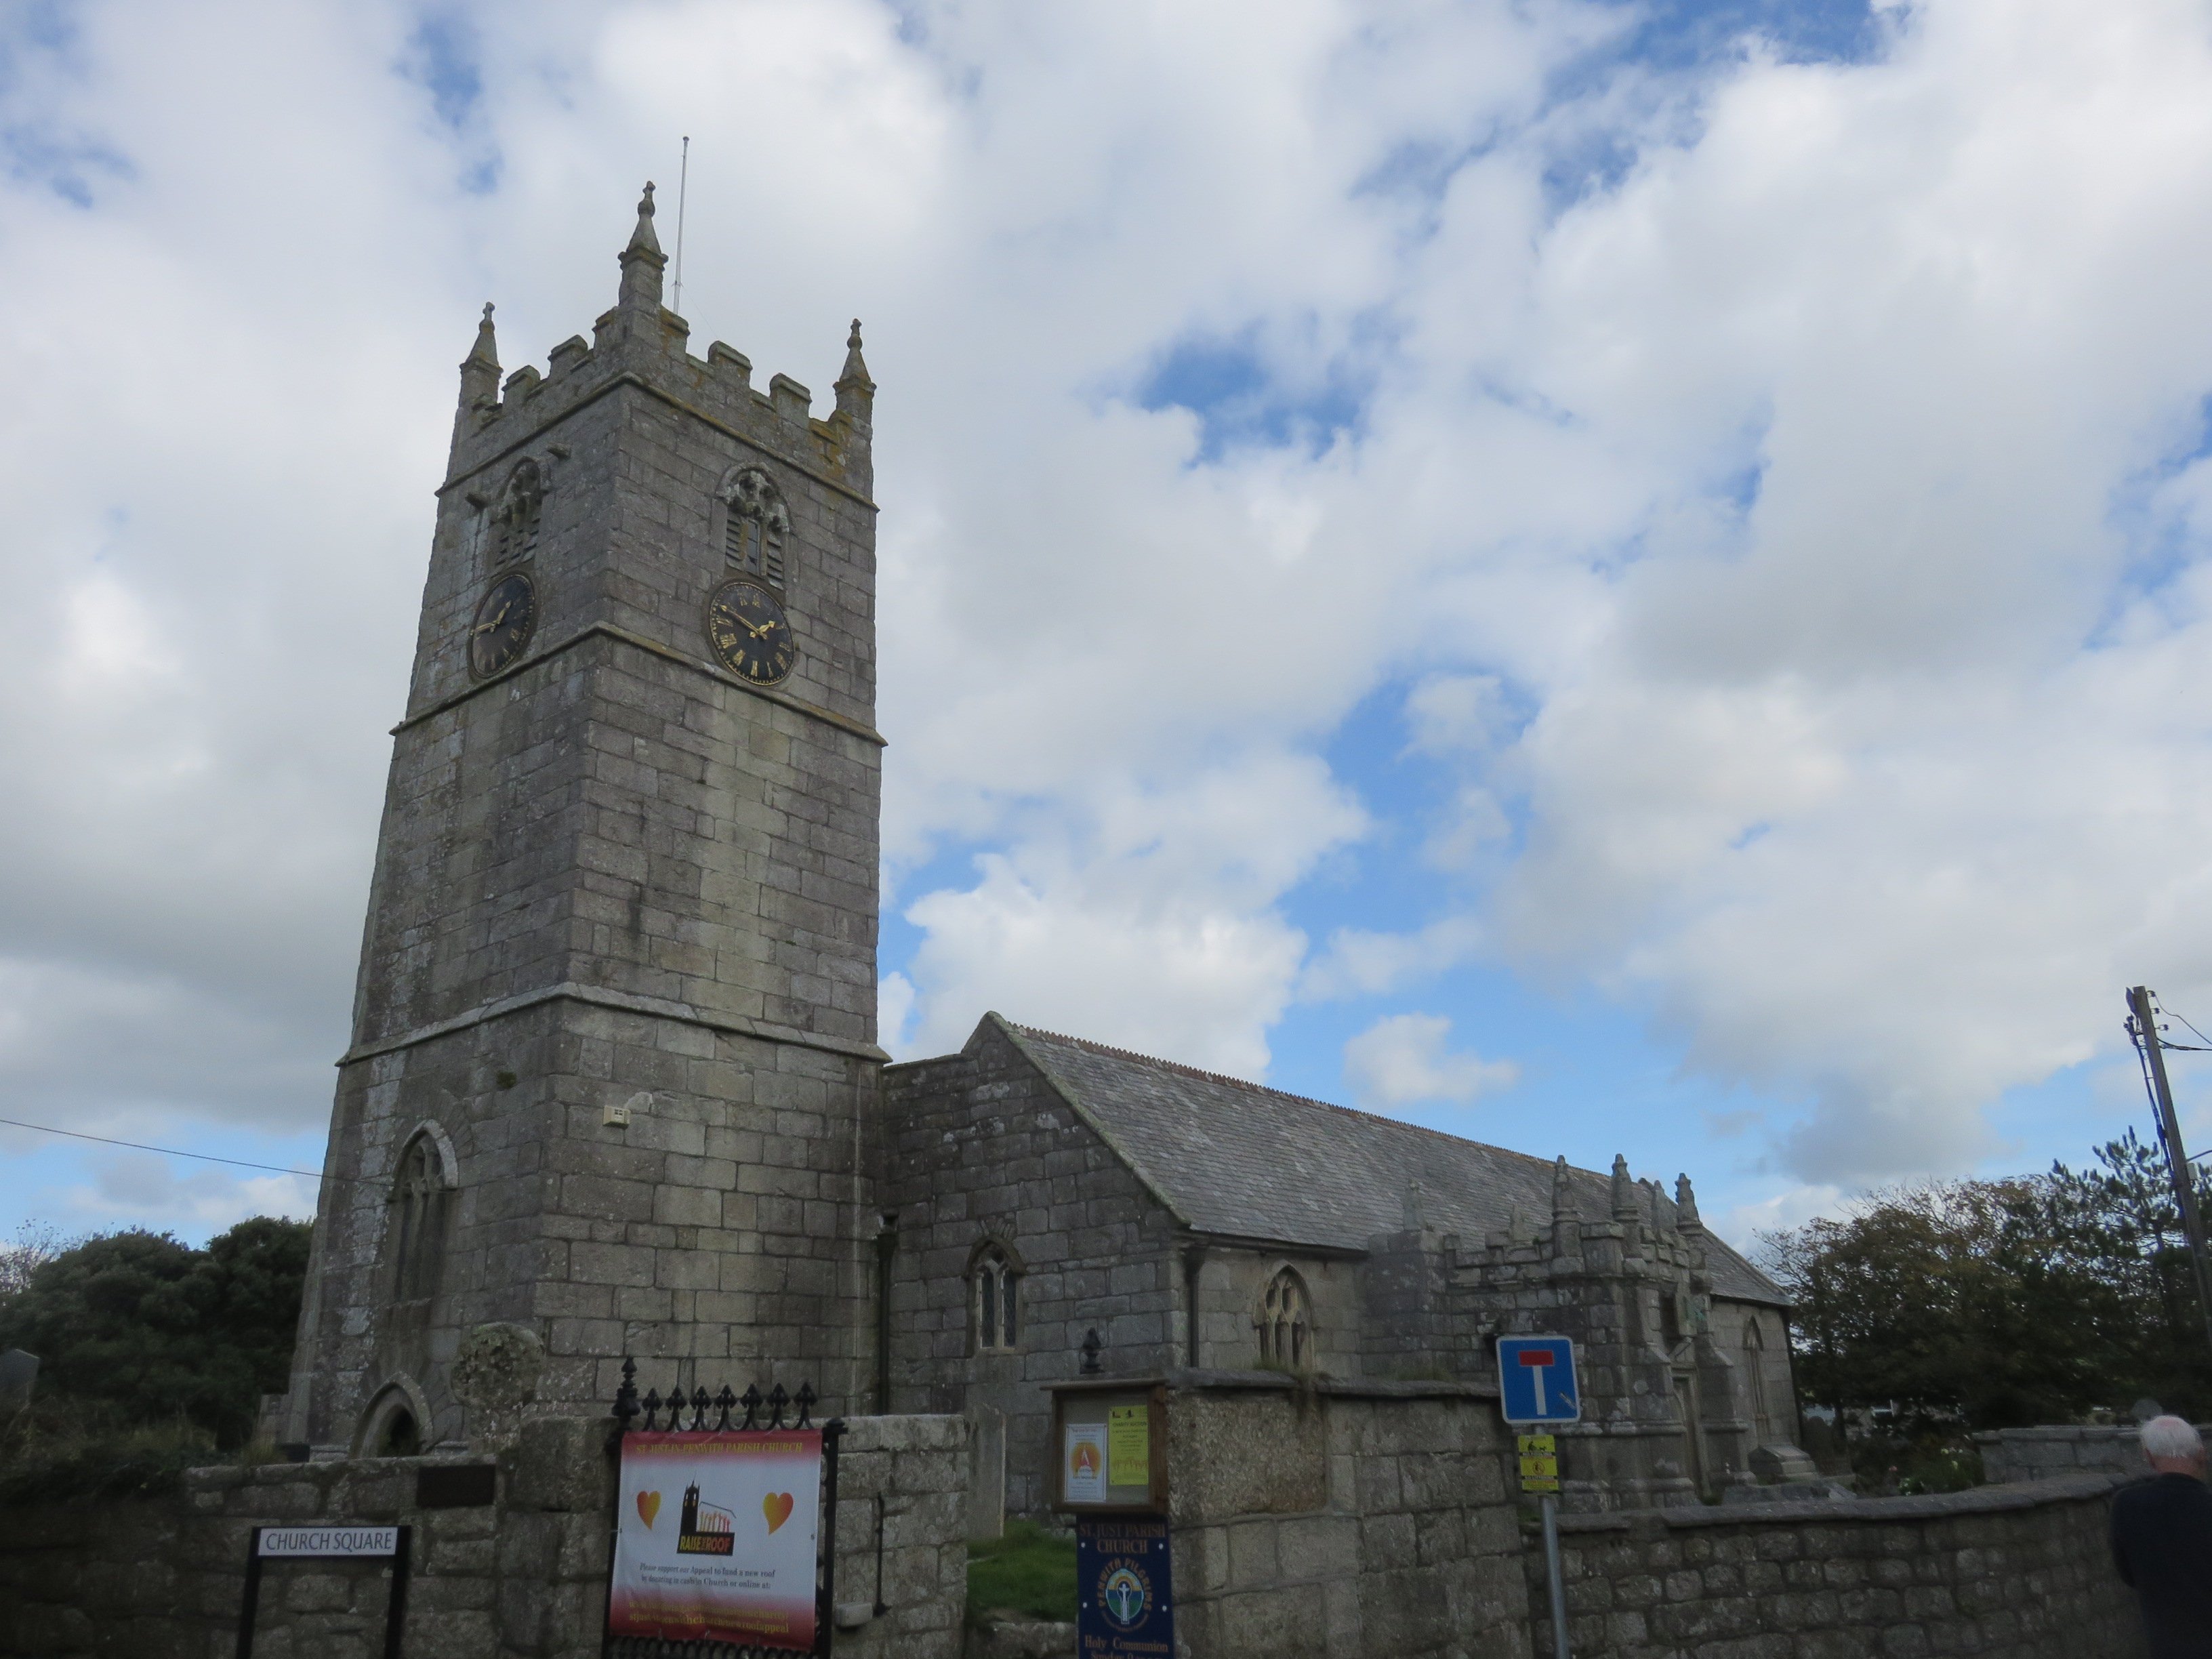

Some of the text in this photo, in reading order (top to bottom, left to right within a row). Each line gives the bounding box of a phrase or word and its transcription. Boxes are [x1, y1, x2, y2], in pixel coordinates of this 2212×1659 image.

[725, 1442, 761, 1453] PARISH
[762, 1442, 803, 1453] CHURCH
[1095, 1523, 1122, 1539] JUST
[1125, 1523, 1166, 1538] PARISH
[266, 1532, 392, 1553] CHURCH SQUARE
[705, 1536, 731, 1552] ROOF
[1097, 1539, 1149, 1554] CHURCH
[690, 1565, 713, 1576] Appeal
[722, 1567, 737, 1576] fund
[760, 1569, 776, 1578] roof
[704, 1577, 728, 1586] Church
[739, 1580, 760, 1589] online
[1085, 1634, 1107, 1650] Holy
